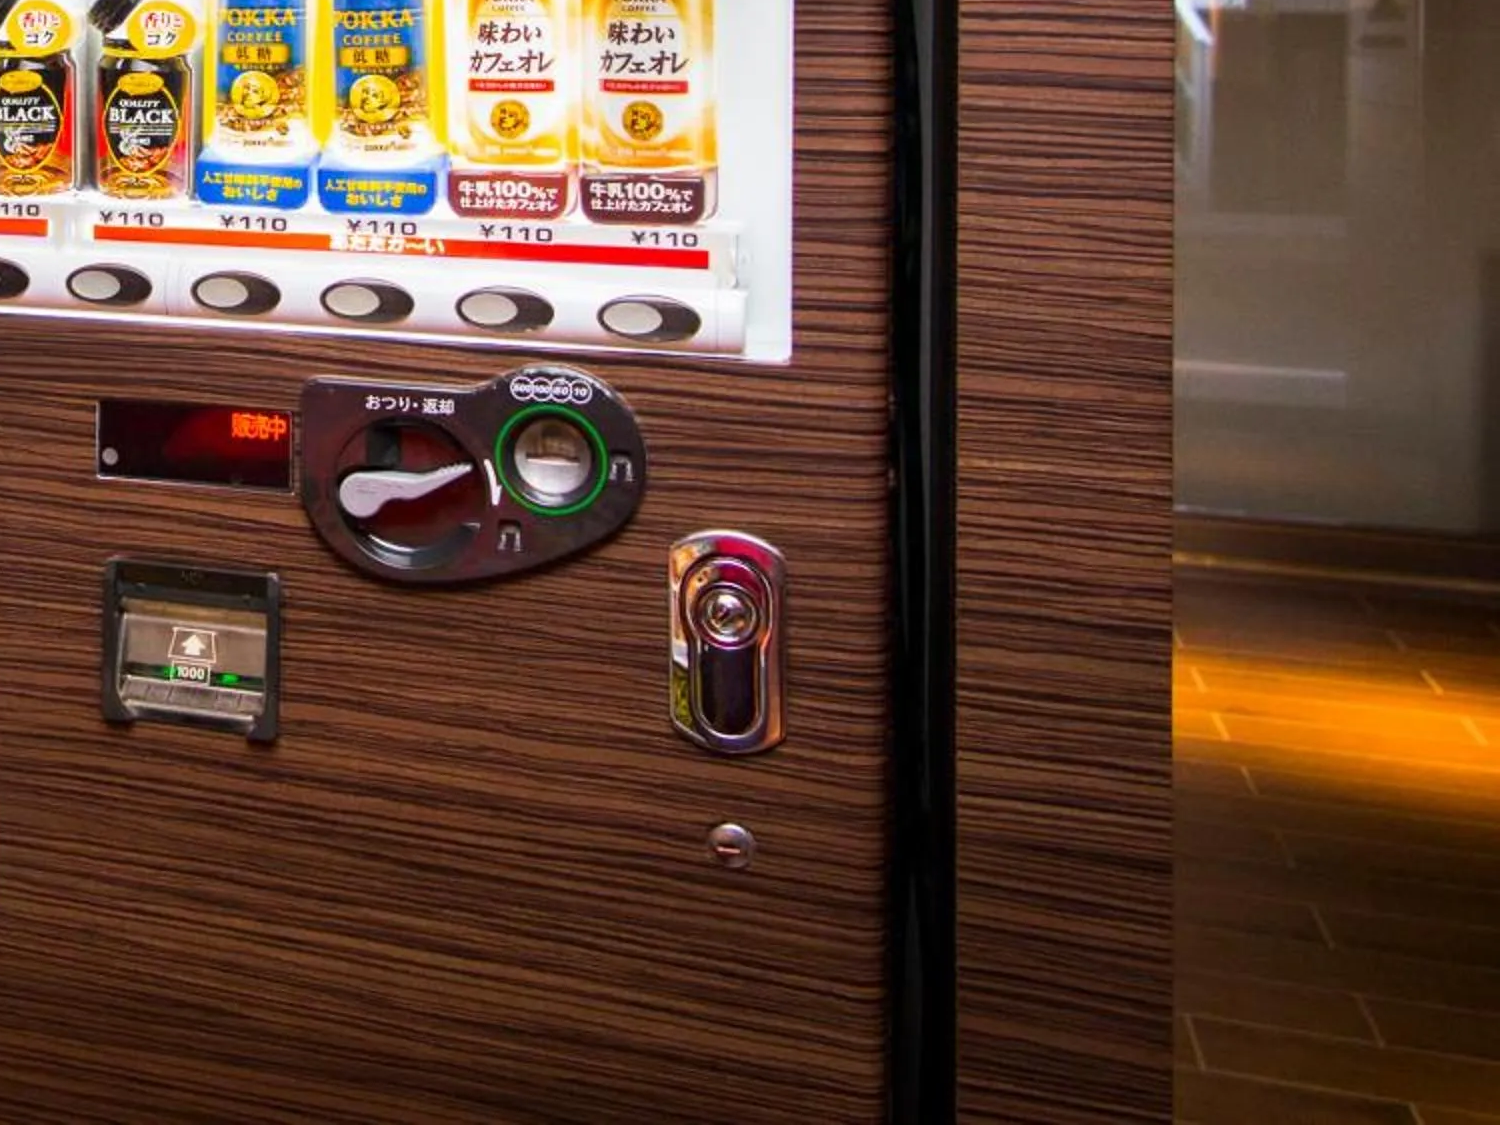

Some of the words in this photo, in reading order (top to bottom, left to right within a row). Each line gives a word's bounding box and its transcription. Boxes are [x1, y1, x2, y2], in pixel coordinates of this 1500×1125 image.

[220, 7, 297, 28] POKKA
[334, 9, 415, 31] POKKA
[25, 29, 55, 45] コク
[147, 29, 177, 46] コク
[227, 31, 283, 43] COFFEE
[343, 34, 402, 46] COFFEE
[478, 21, 542, 45] 味わい
[608, 22, 675, 46] 味わい
[469, 49, 555, 74] カフェオレ
[600, 50, 690, 75] カフェオレ
[109, 107, 174, 125] BLACK
[458, 180, 559, 199] 牛乳100%で
[589, 181, 693, 200] 牛乳100%で
[460, 197, 559, 213] 仕上げたカフェオレ
[590, 197, 693, 214] 仕上げたカフェオレ
[99, 211, 164, 227] ¥110
[220, 214, 287, 232] ¥110
[347, 218, 417, 236] ¥110
[480, 224, 553, 242] ¥110
[631, 230, 699, 248] ¥110
[365, 393, 456, 415] おつり・返却
[232, 412, 288, 441] 販売中
[177, 665, 205, 681] 1000
